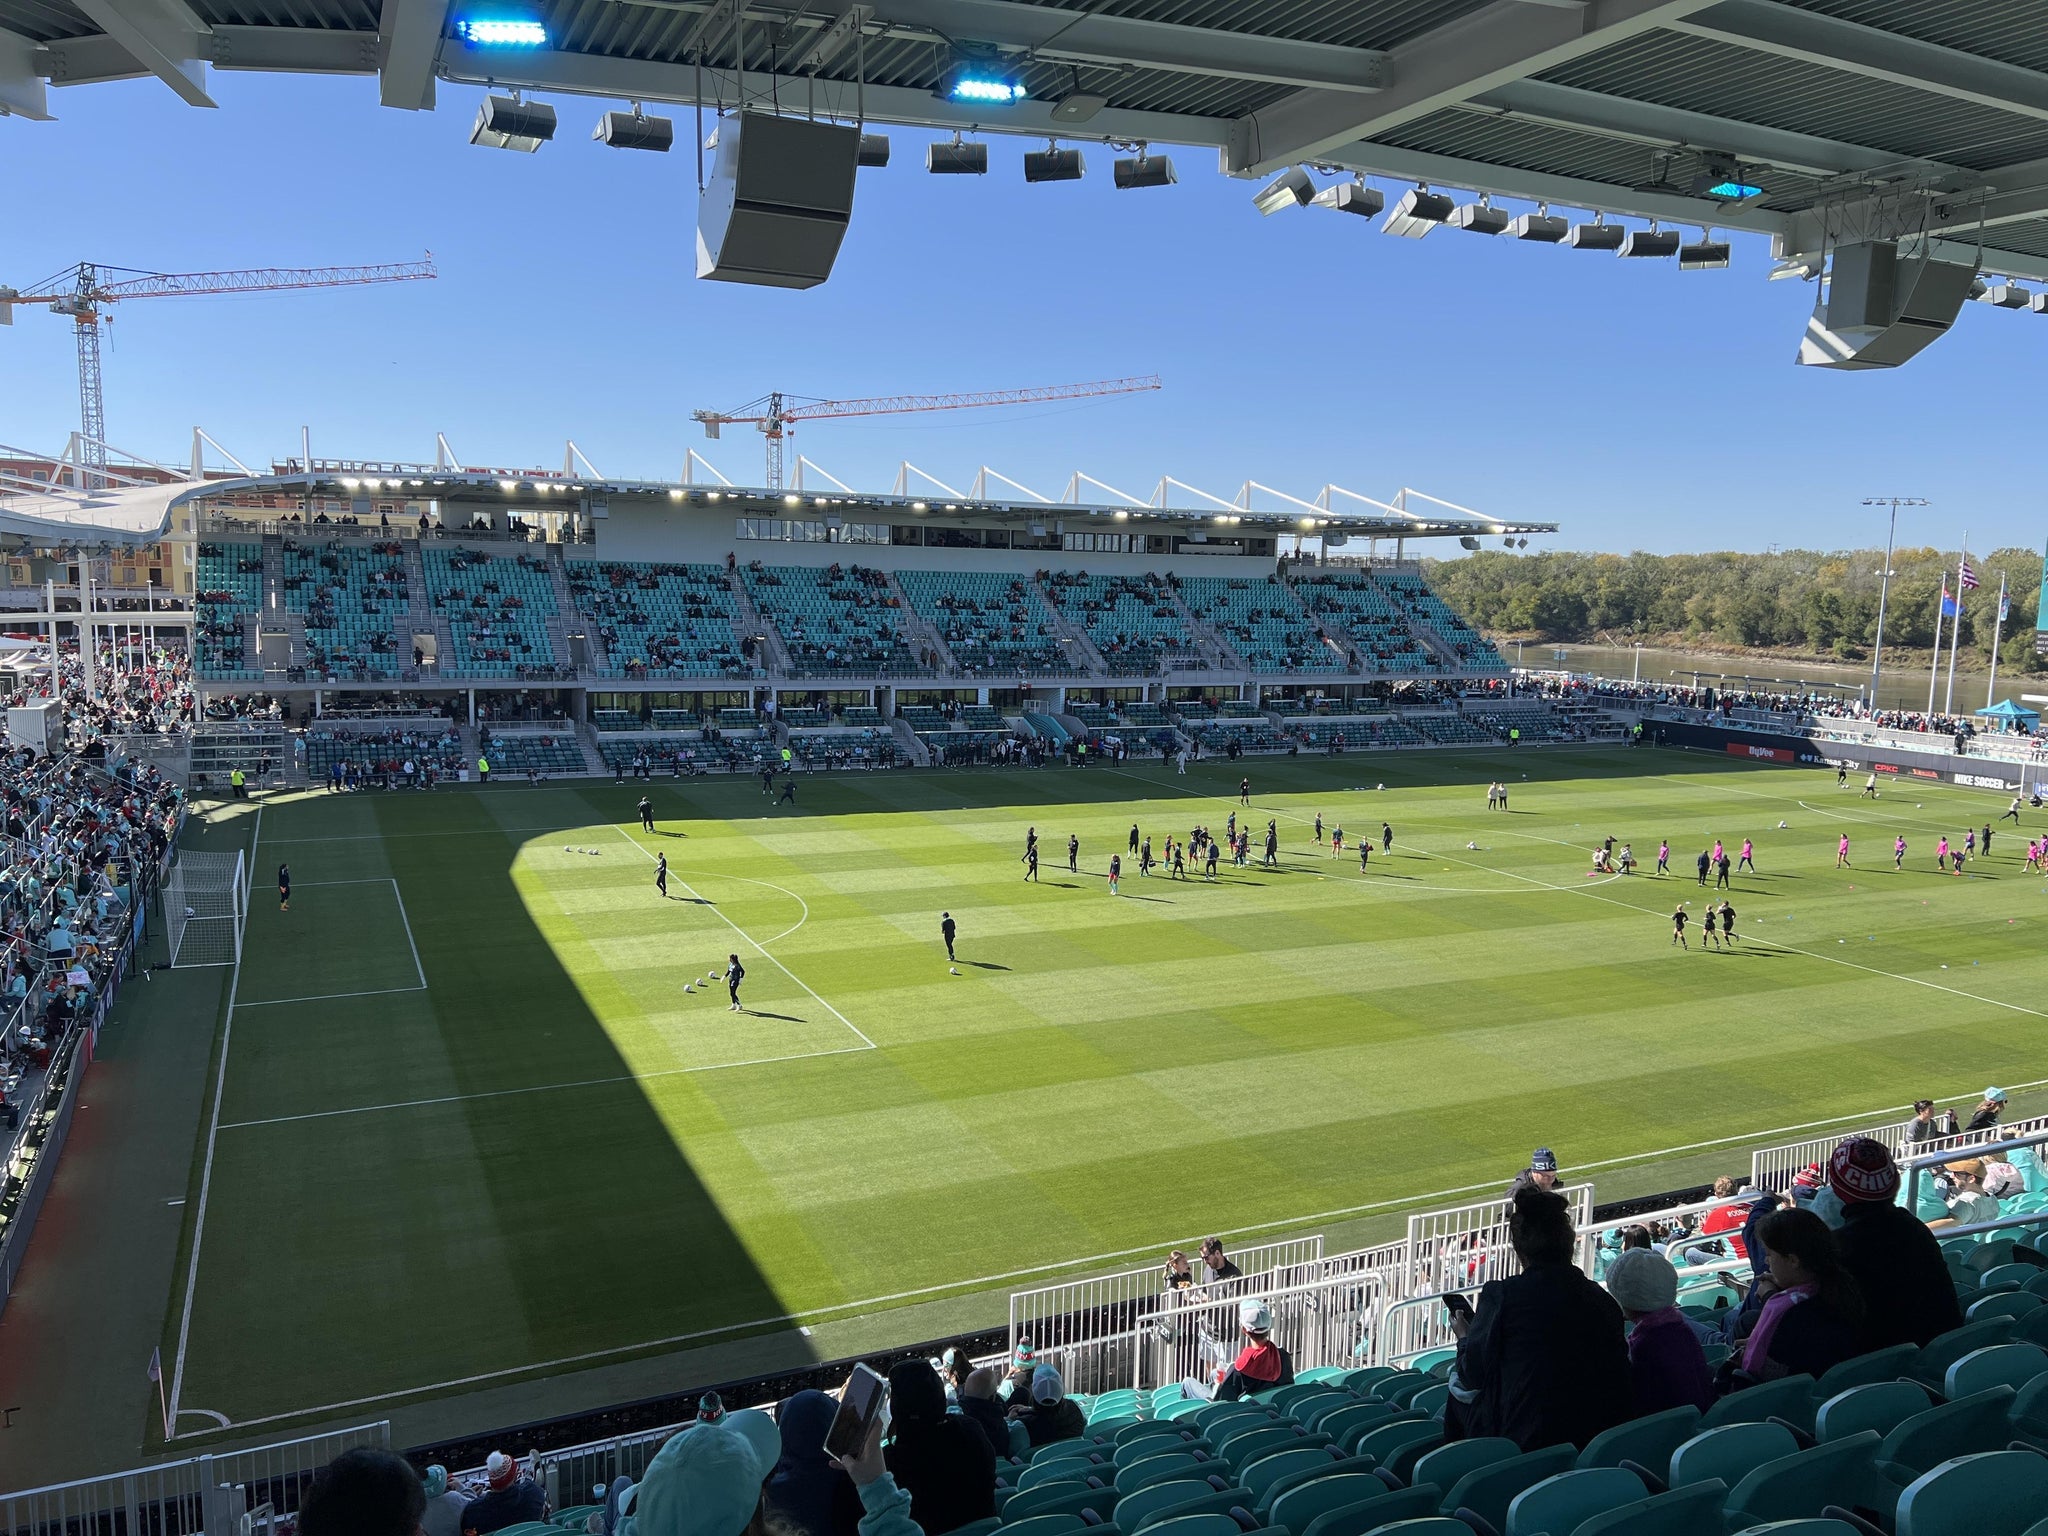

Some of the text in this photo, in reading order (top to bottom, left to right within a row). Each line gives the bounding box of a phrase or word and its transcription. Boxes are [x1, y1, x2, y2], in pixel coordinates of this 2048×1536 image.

[1813, 755, 1842, 767] Kansas
[1874, 763, 1899, 773] CPKC
[1954, 773, 1973, 786] NIKE
[1974, 775, 2004, 789] SOCCER
[1844, 1167, 1893, 1191] CHIE
